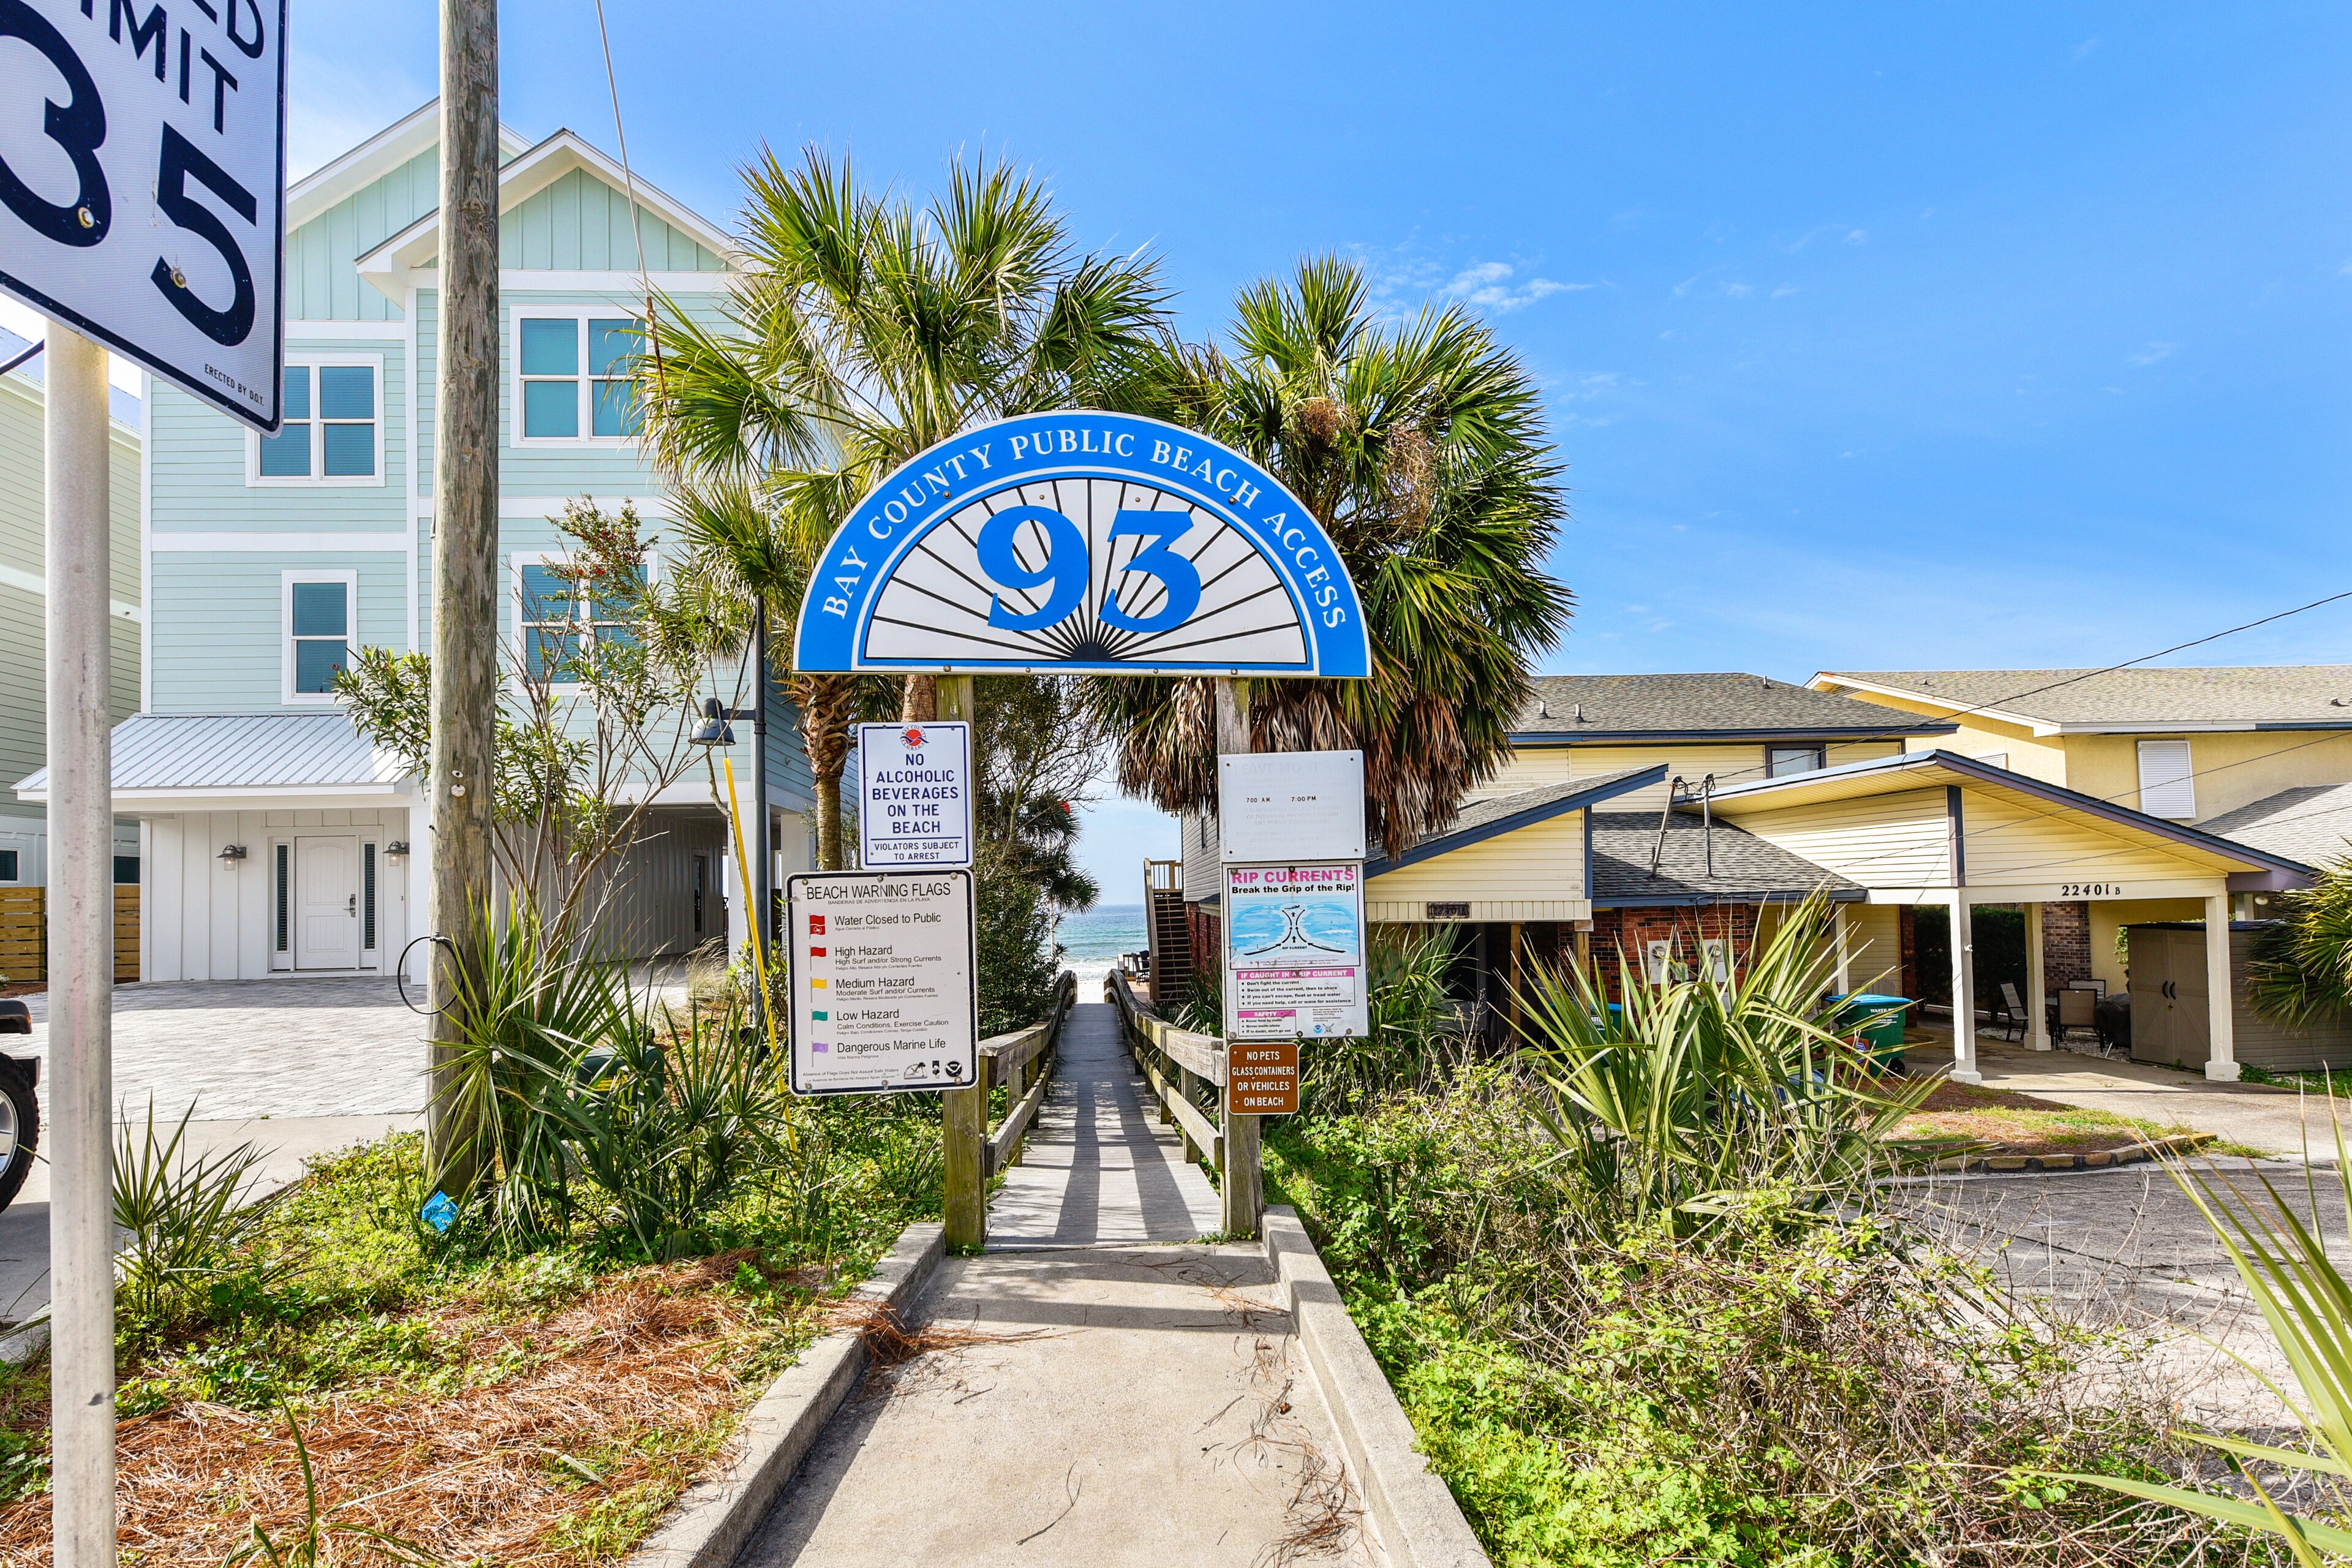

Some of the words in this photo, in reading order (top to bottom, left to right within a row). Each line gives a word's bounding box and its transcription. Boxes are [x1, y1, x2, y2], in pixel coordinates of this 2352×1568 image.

[81, 0, 238, 135] MIT
[0, 0, 256, 347] 35
[205, 364, 235, 388] ERECTED
[238, 383, 246, 395] BY
[250, 390, 264, 406] D.O.T.
[823, 545, 869, 619] BAY
[869, 443, 992, 540] COUNTY
[1009, 429, 1135, 460] PUBLIC
[1150, 439, 1262, 511] BEACH
[1261, 512, 1346, 628] ACCESS
[977, 505, 1201, 633] 93
[906, 754, 924, 766] NO
[876, 770, 954, 783] ALCOHOLIC
[872, 787, 958, 800] BEVERAGES
[888, 805, 906, 816] ON
[912, 804, 939, 816] THE
[892, 821, 940, 834] BEACH
[1232, 872, 1259, 884] RIP
[1264, 869, 1354, 883] CURRENTS
[807, 886, 848, 899] BEACH
[851, 884, 908, 897] WARNING
[912, 883, 950, 896] FLAGS
[2062, 884, 2109, 896] 22401
[835, 915, 862, 925] Water
[866, 914, 898, 925] Closed
[902, 914, 910, 923] to
[914, 913, 941, 922] Public
[835, 946, 855, 959] High
[859, 945, 892, 956] Hazard
[836, 979, 875, 989] Medium
[879, 976, 914, 987] Hazard
[837, 1011, 858, 1020] Low
[862, 1009, 899, 1020] Hazard
[837, 1043, 890, 1054] Dangerous
[894, 1040, 925, 1050] Marine
[929, 1039, 946, 1048] Life
[1247, 1052, 1257, 1060] NO
[1260, 1052, 1280, 1060] PETS
[1232, 1067, 1253, 1076] GLASS
[1254, 1066, 1294, 1075] CONTAINERS
[1238, 1082, 1248, 1091] OR
[1251, 1082, 1289, 1091] VEHICLES
[1244, 1098, 1255, 1106] ON
[1257, 1097, 1283, 1106] BEACH
